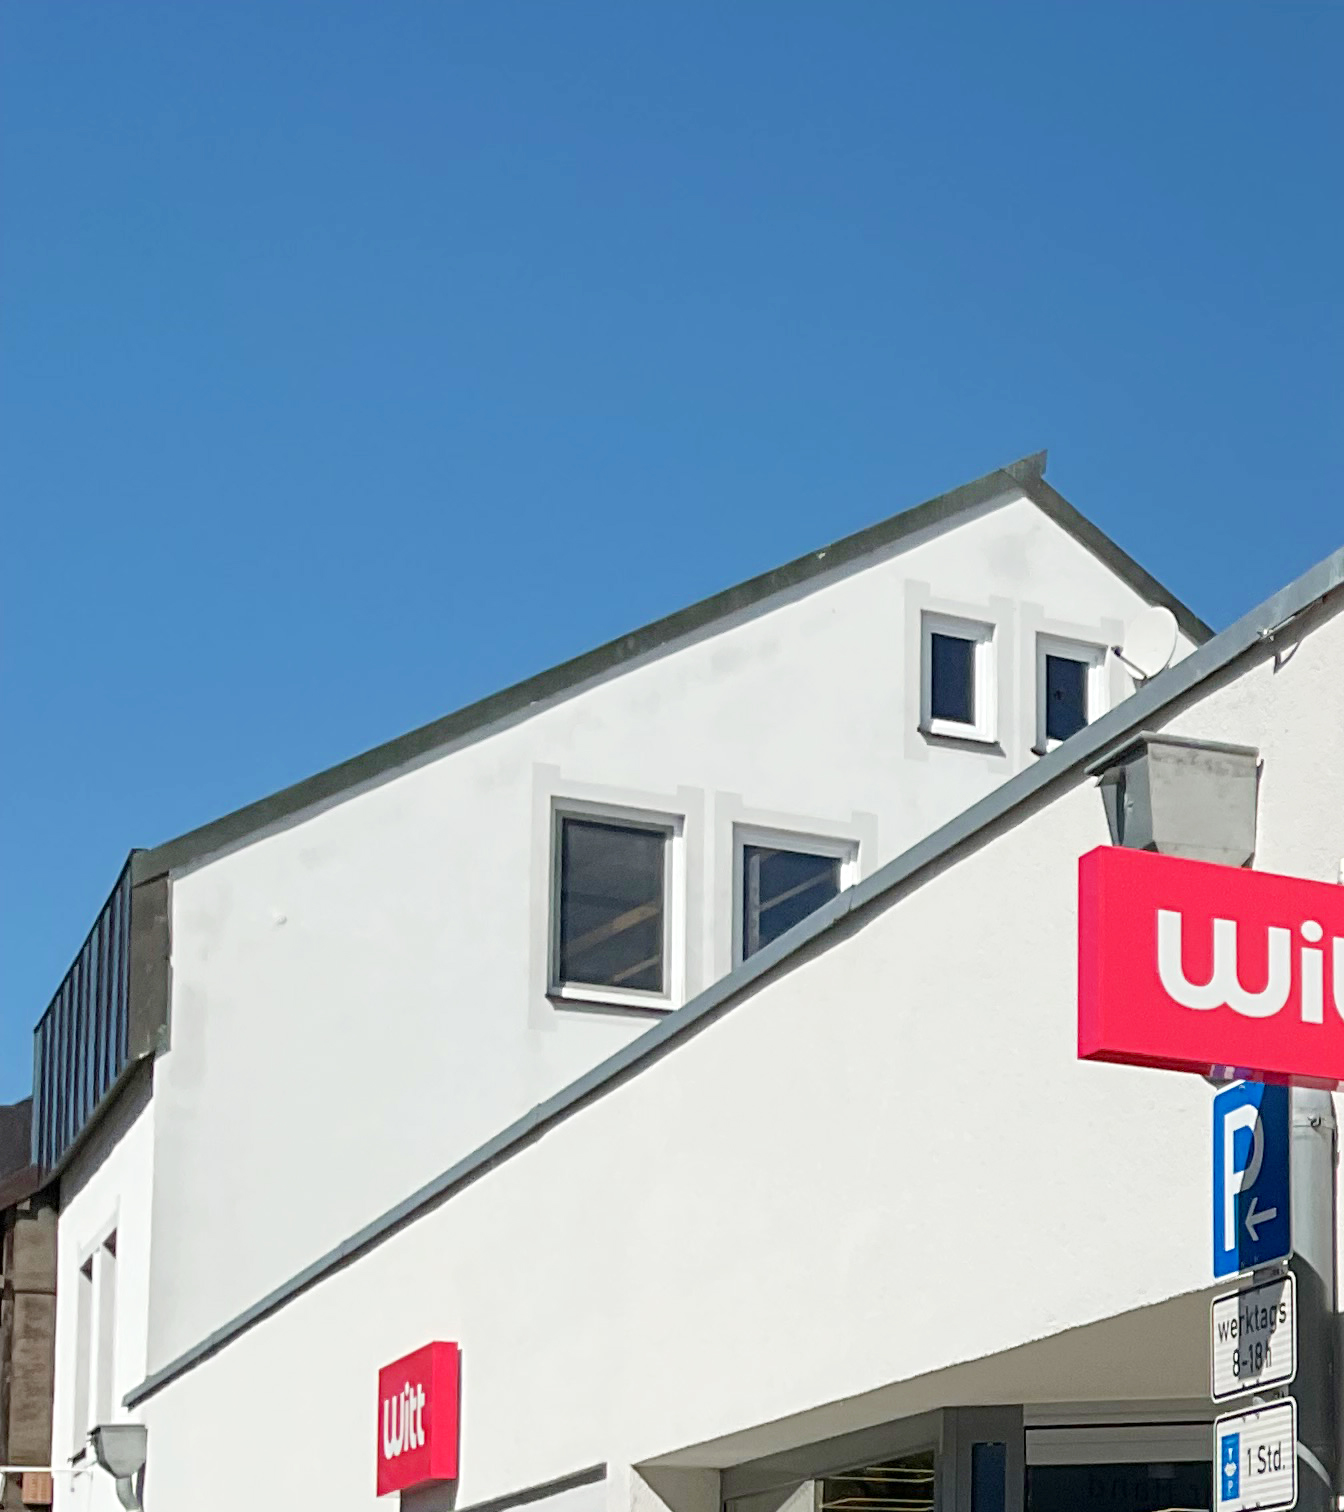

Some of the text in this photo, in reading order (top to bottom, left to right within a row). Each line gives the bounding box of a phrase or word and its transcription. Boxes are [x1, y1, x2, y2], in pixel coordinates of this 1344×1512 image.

[1224, 1104, 1264, 1252] P
[1217, 1301, 1287, 1342] werktags
[383, 1381, 425, 1460] Witt
[1247, 1441, 1286, 1477] 1 Std.
